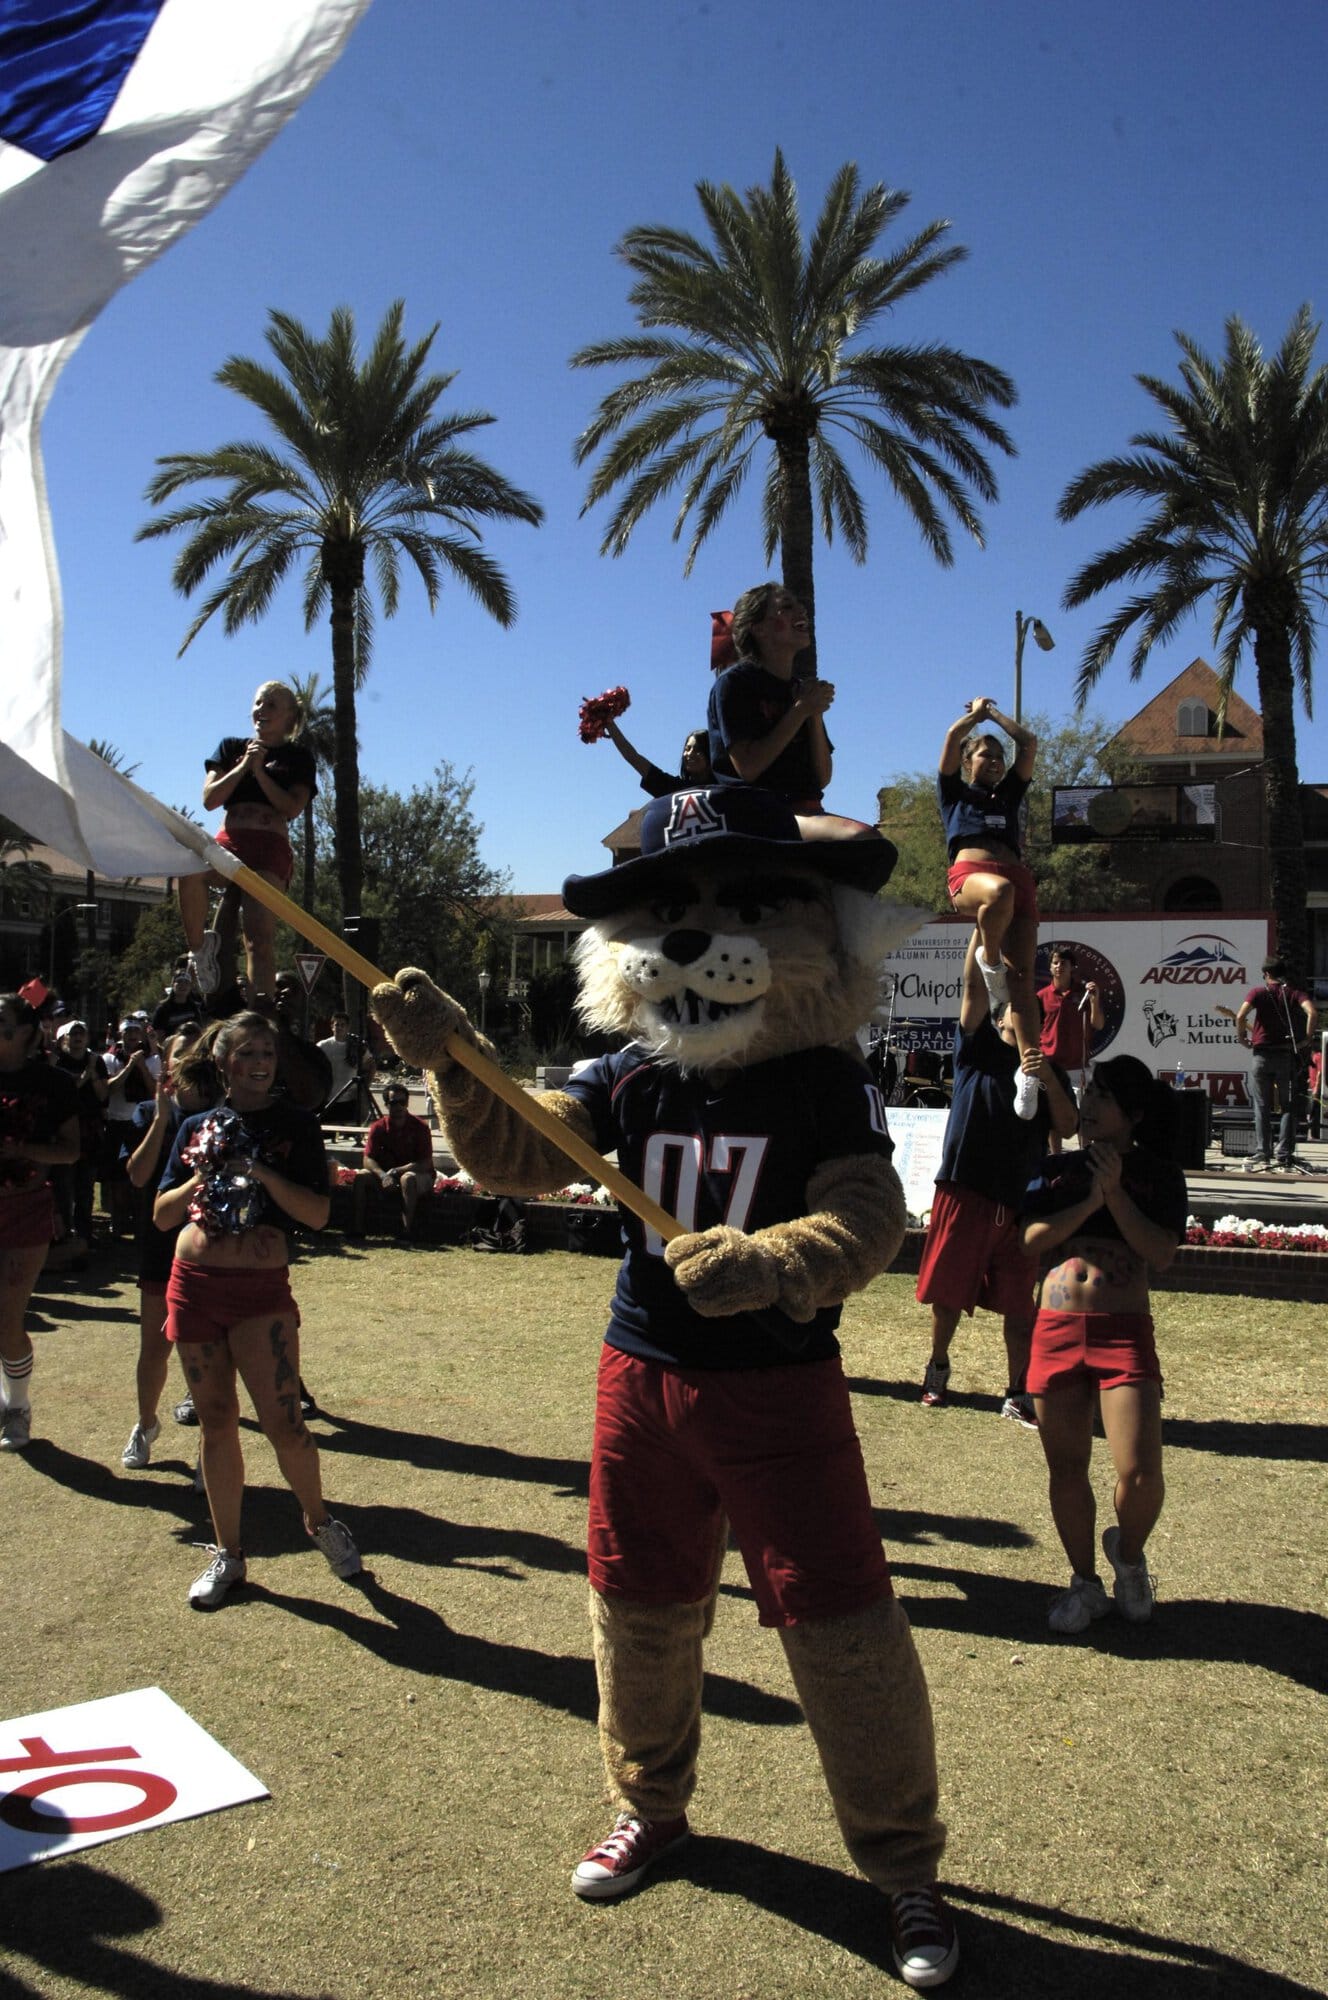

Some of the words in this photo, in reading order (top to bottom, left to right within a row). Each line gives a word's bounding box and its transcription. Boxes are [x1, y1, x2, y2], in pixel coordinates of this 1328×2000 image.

[663, 789, 728, 848] A
[911, 938, 951, 946] UNIVERSITY
[894, 950, 929, 960] ALUMNI
[934, 950, 966, 960] ASSOC
[1139, 966, 1247, 985] ARIZONA
[900, 973, 963, 1006] Chipot
[1187, 1014, 1248, 1028] Libert
[871, 1031, 956, 1040] MRSHAL
[1187, 1031, 1248, 1044] Mutua
[642, 1130, 772, 1258] 07
